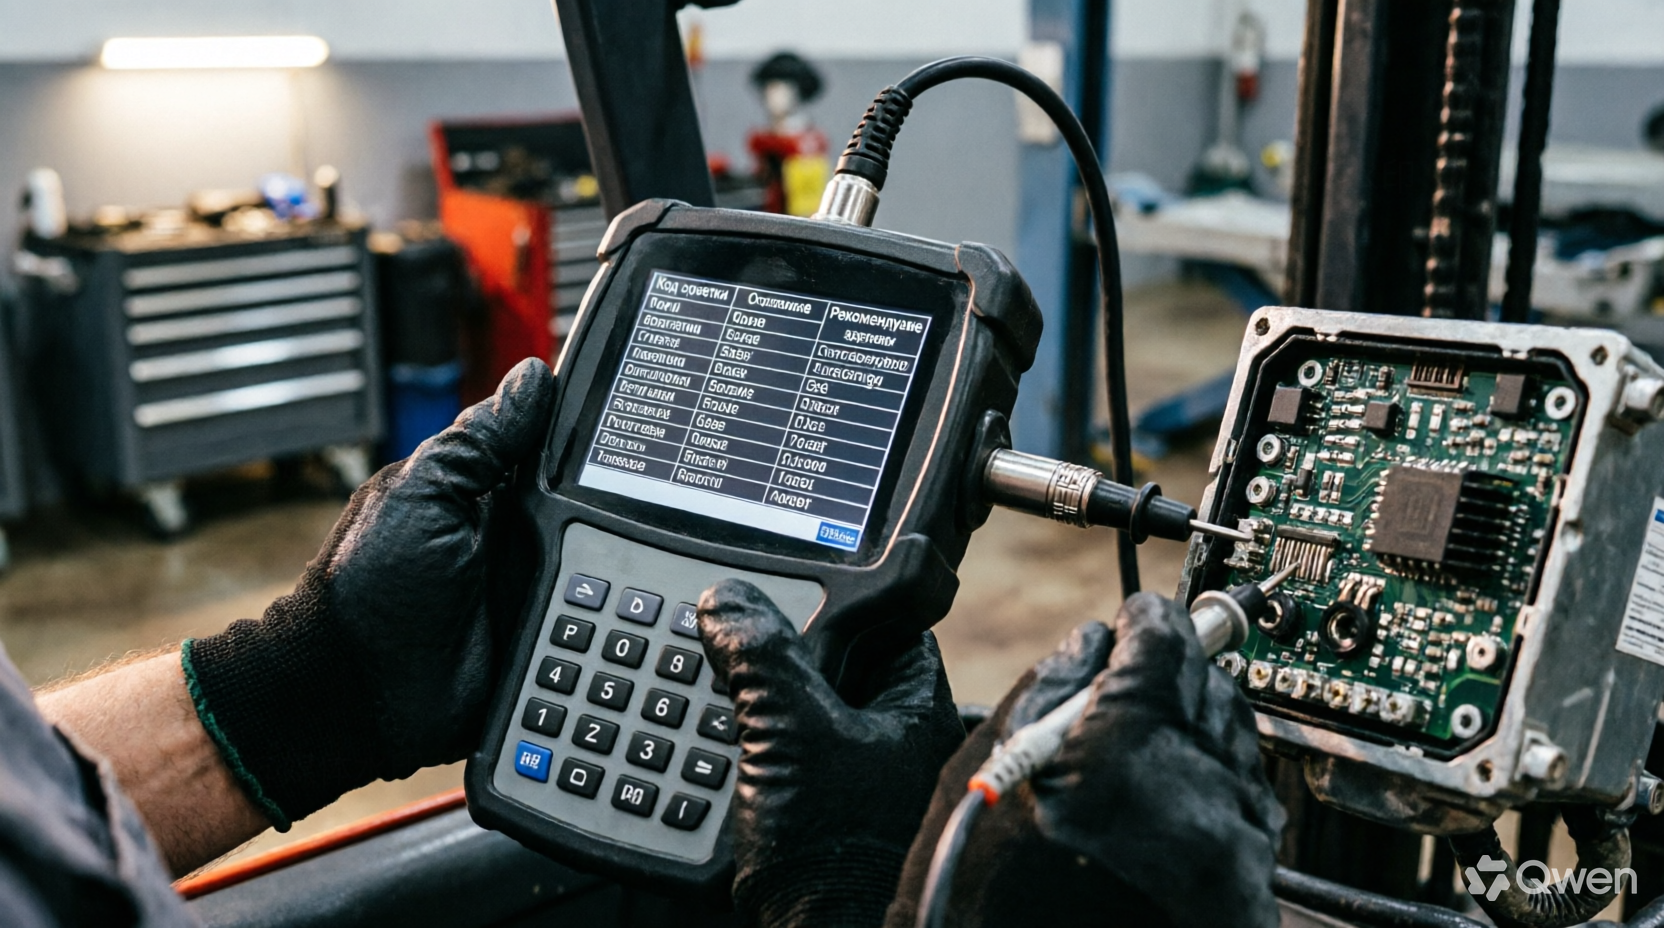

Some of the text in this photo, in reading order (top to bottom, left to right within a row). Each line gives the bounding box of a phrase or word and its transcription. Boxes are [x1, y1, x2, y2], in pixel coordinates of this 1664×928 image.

[656, 276, 679, 295] Код
[563, 625, 578, 640] P
[670, 655, 684, 673] 8
[550, 666, 562, 684] 4
[601, 682, 615, 699] 5
[655, 698, 670, 716] 6
[538, 708, 547, 726] 1
[639, 740, 655, 759] 3
